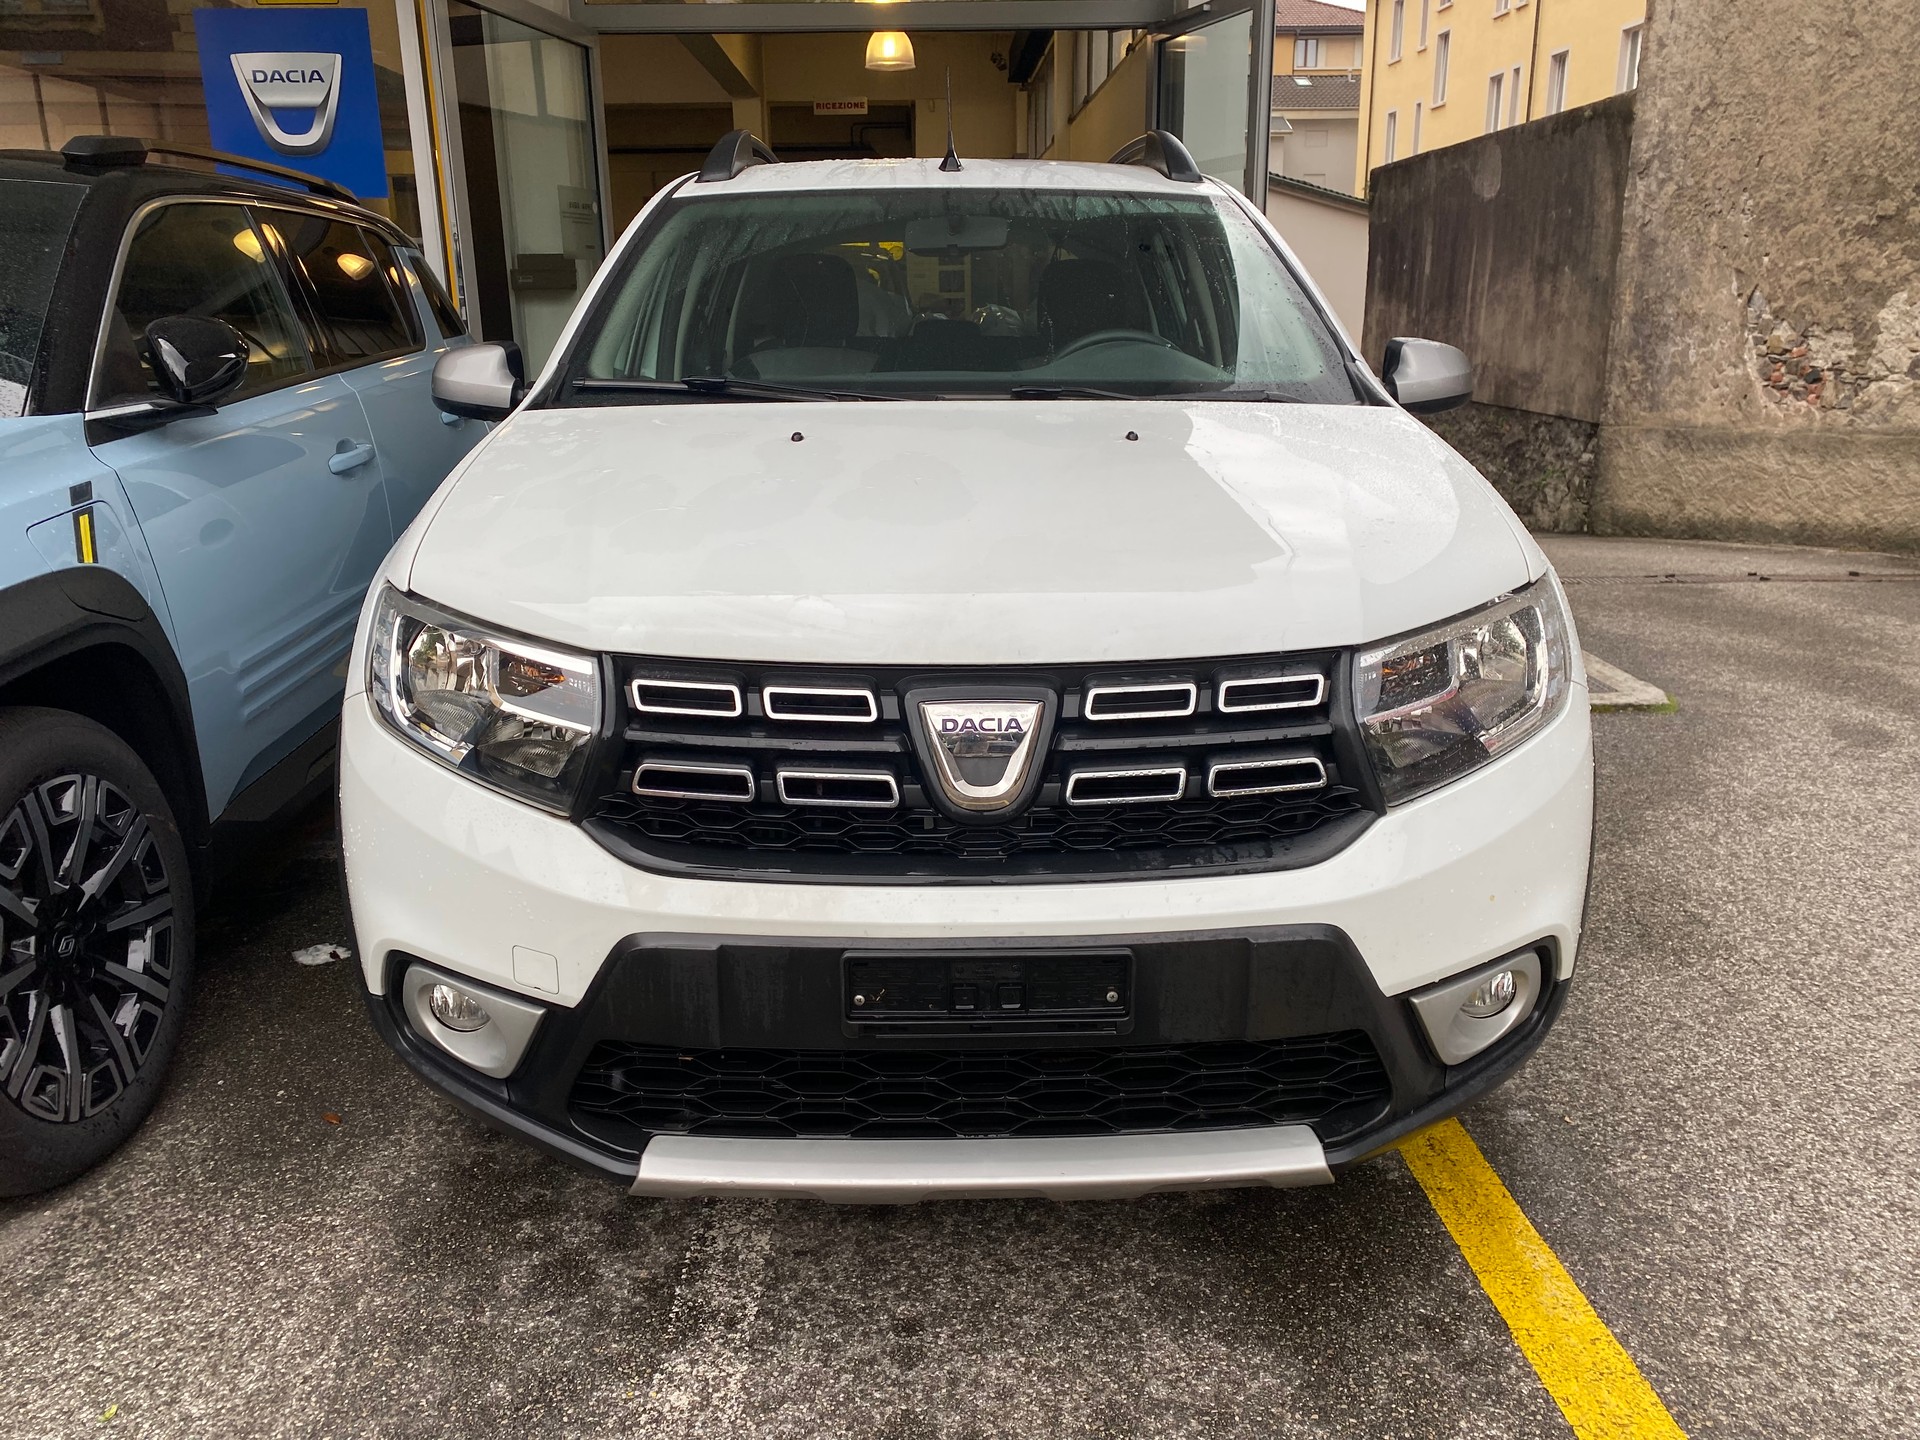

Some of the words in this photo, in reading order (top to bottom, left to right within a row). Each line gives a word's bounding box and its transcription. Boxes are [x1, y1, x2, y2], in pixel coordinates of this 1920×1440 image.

[252, 70, 325, 83] DACIA
[815, 101, 865, 110] RICEZIONE
[942, 718, 1024, 732] DACIA
